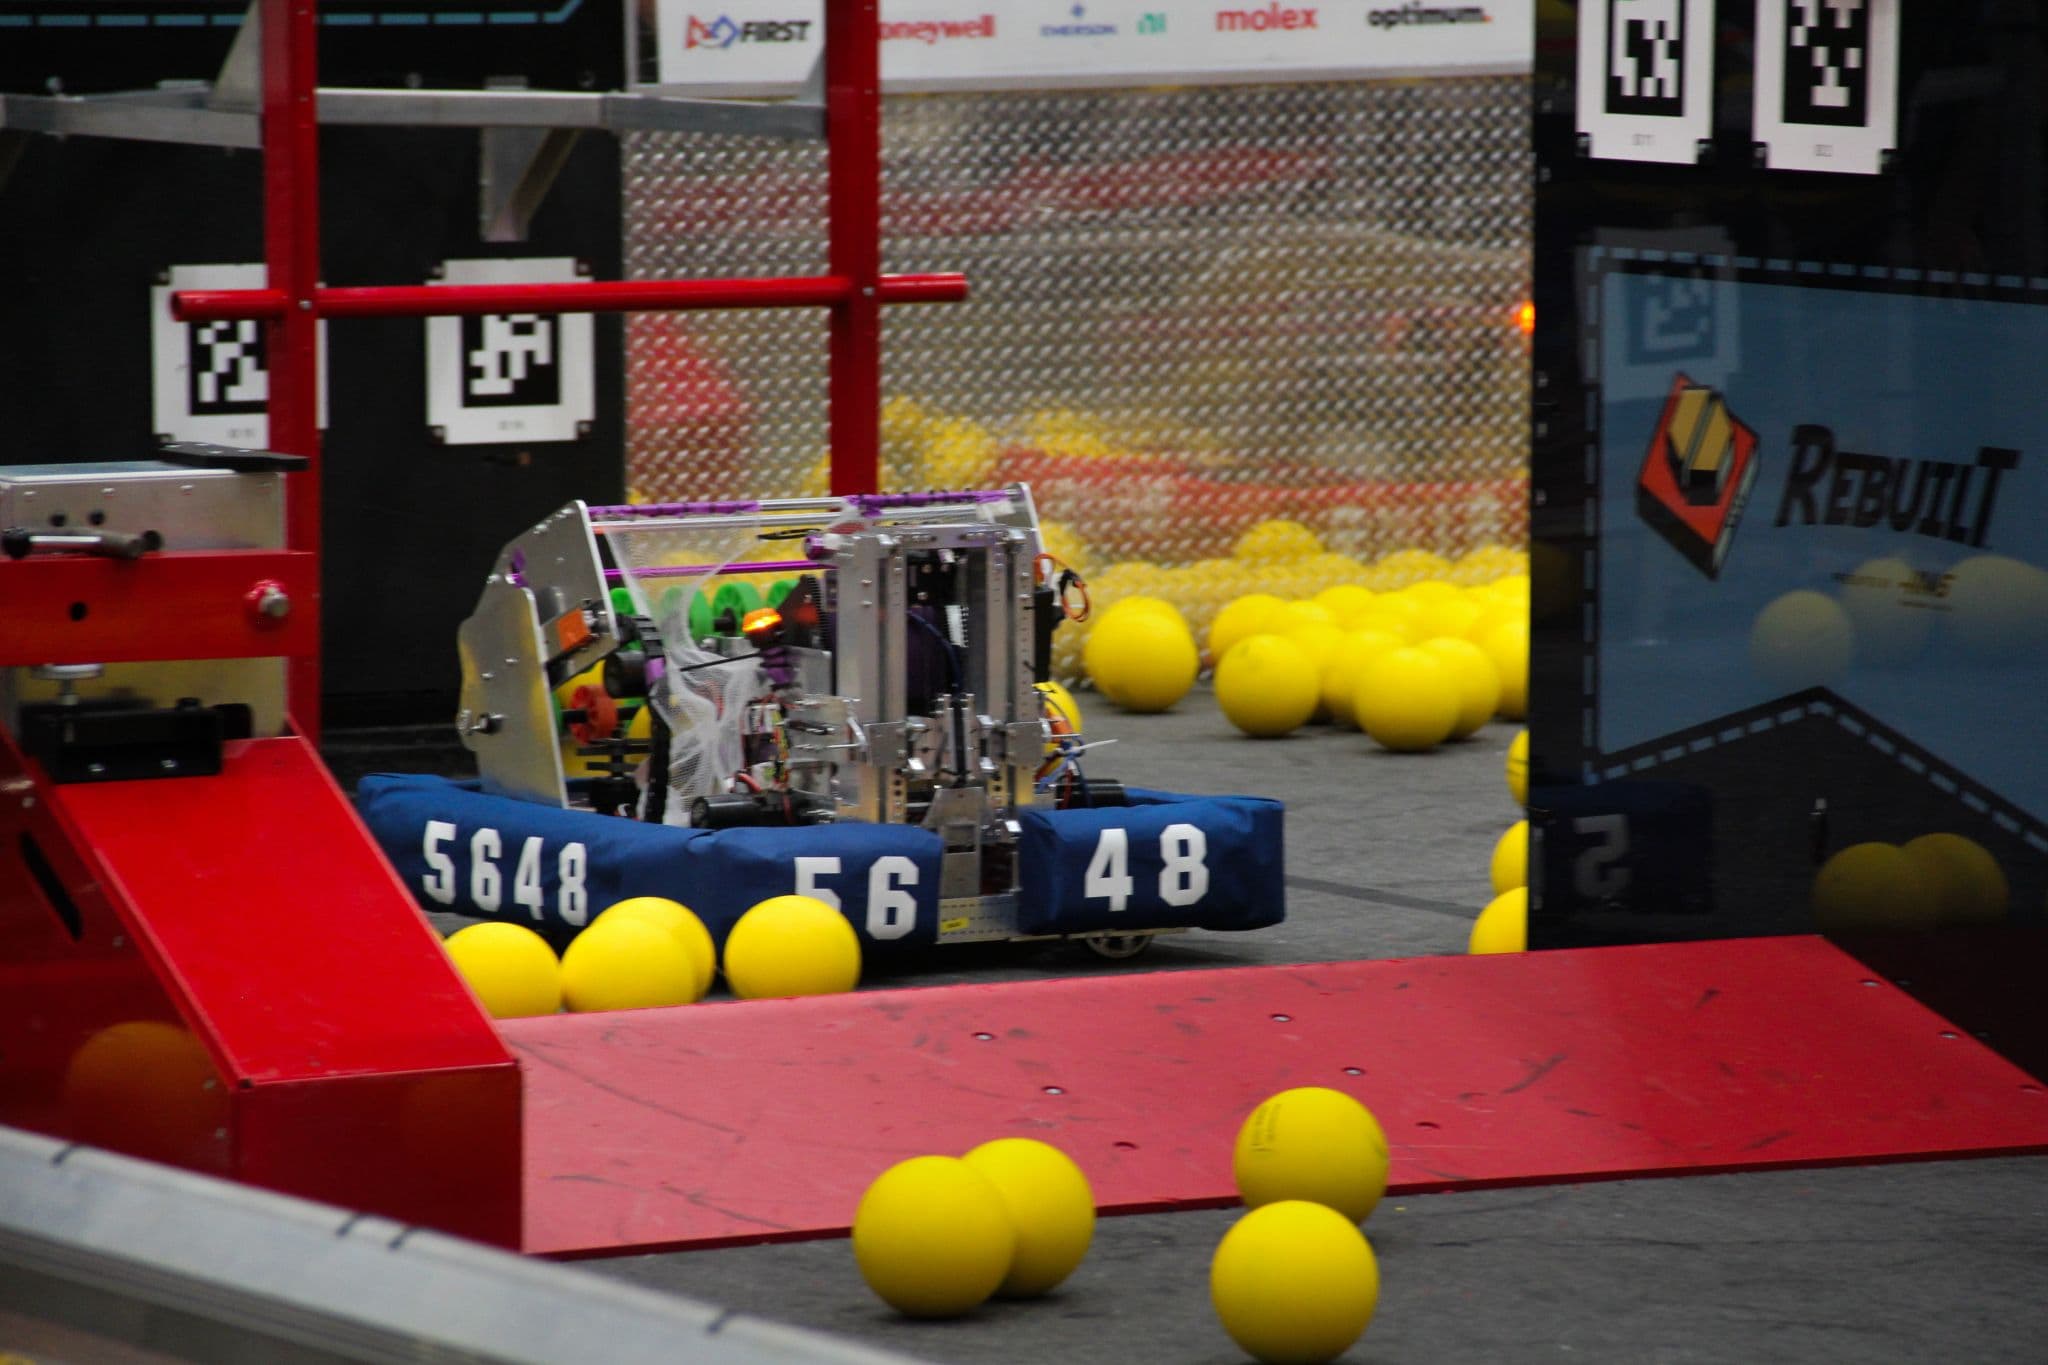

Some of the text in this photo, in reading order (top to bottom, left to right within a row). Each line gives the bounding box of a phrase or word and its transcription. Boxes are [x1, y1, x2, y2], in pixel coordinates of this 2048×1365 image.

[741, 20, 811, 42] FIRST
[879, 14, 997, 45] oneywell
[1216, 1, 1318, 31] molex
[423, 820, 587, 926] 5648
[1084, 823, 1209, 912] 48
